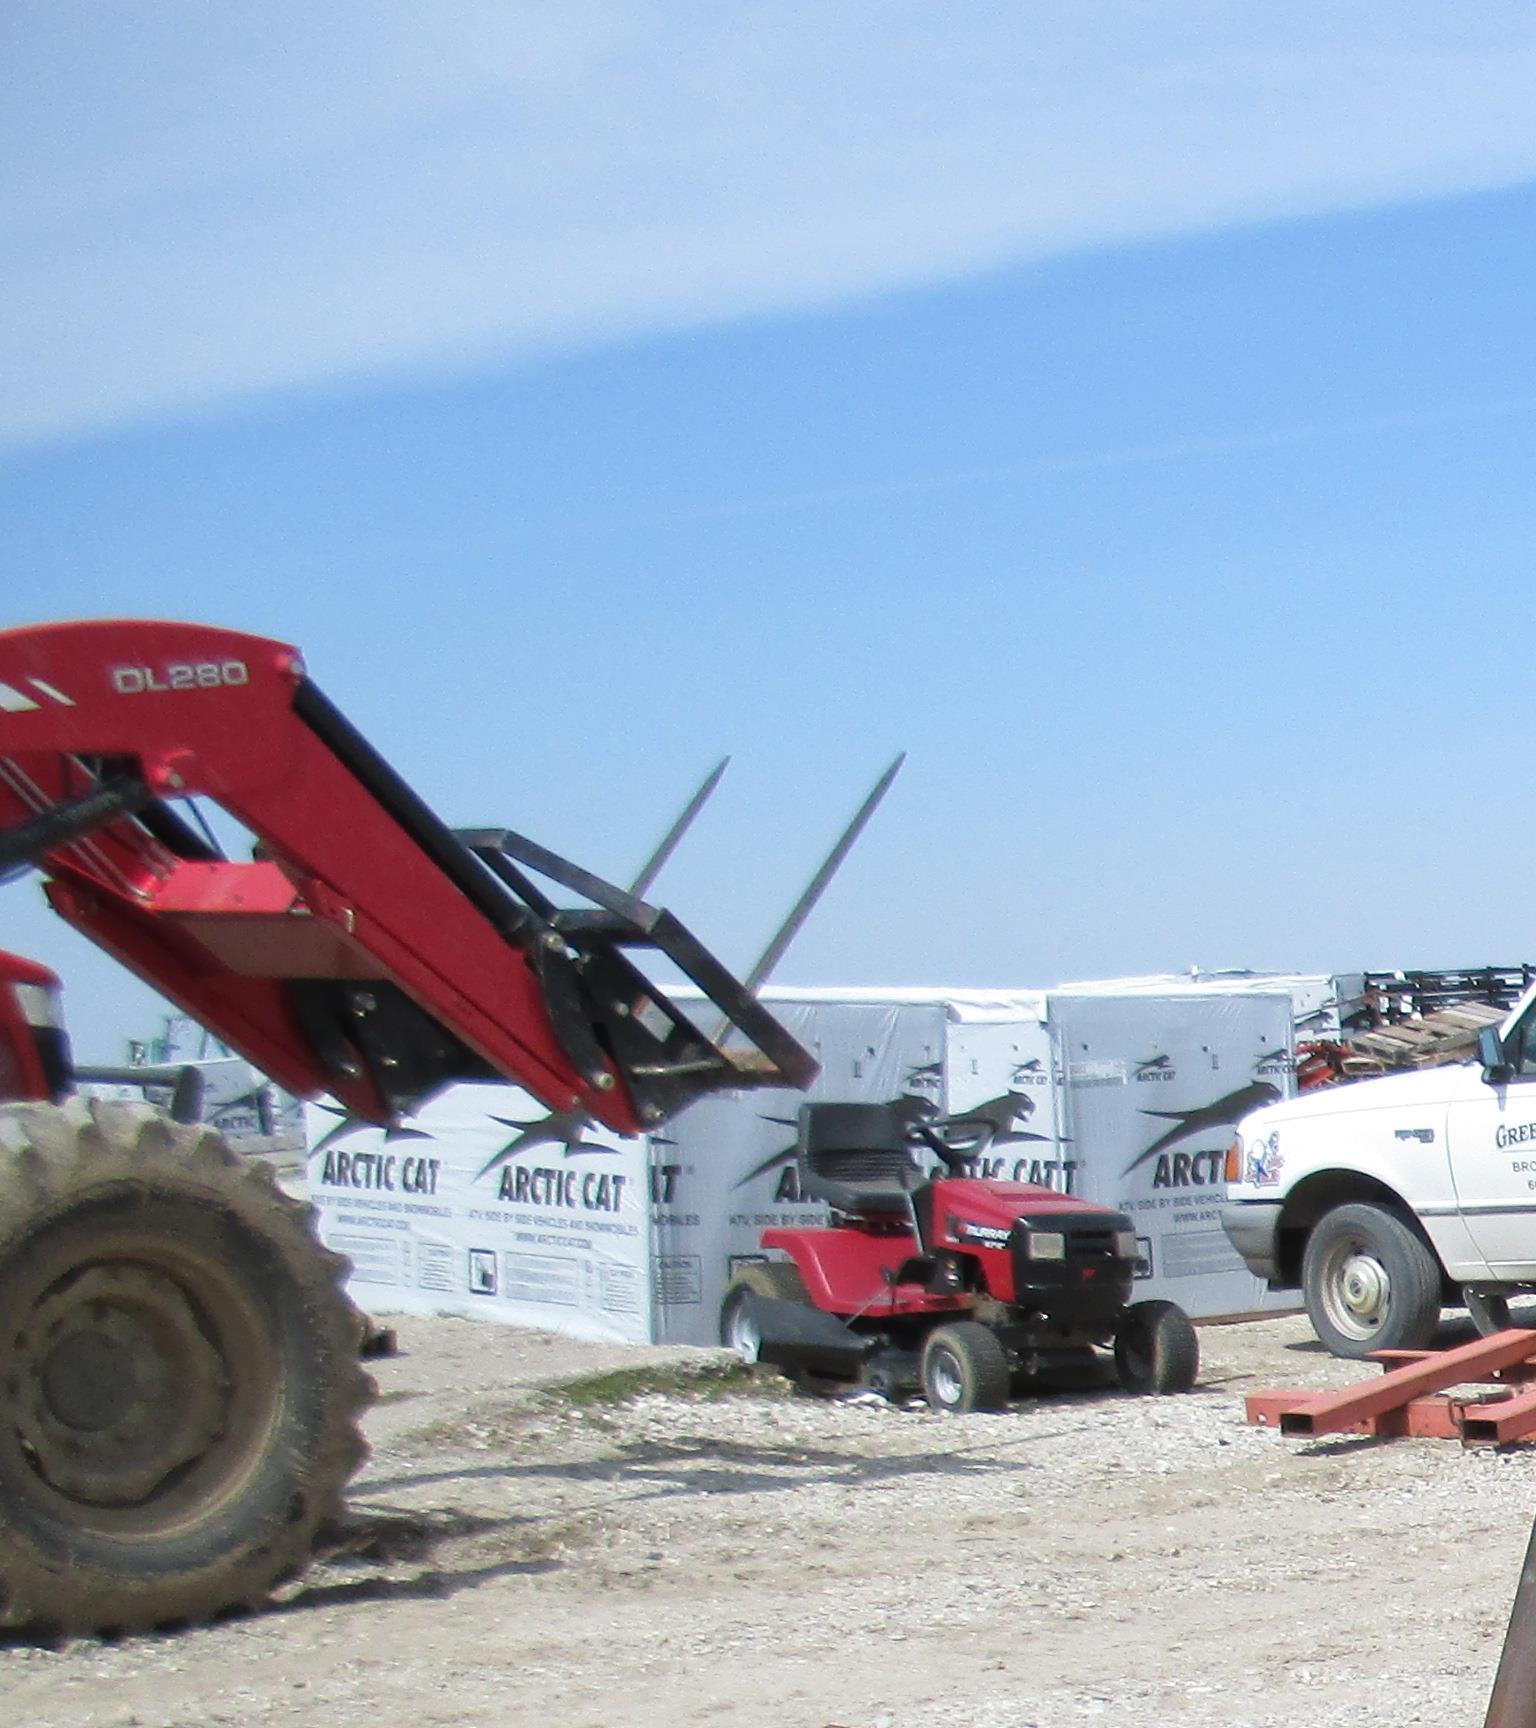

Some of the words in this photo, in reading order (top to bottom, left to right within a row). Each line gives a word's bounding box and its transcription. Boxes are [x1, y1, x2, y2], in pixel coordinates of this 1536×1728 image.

[112, 661, 248, 694] DL280
[322, 1150, 396, 1192] ARCTIC
[402, 1156, 441, 1195] CAT
[499, 1164, 577, 1209] ARCTIC
[582, 1171, 626, 1213] CAT
[1152, 1149, 1230, 1189] ARCTI
